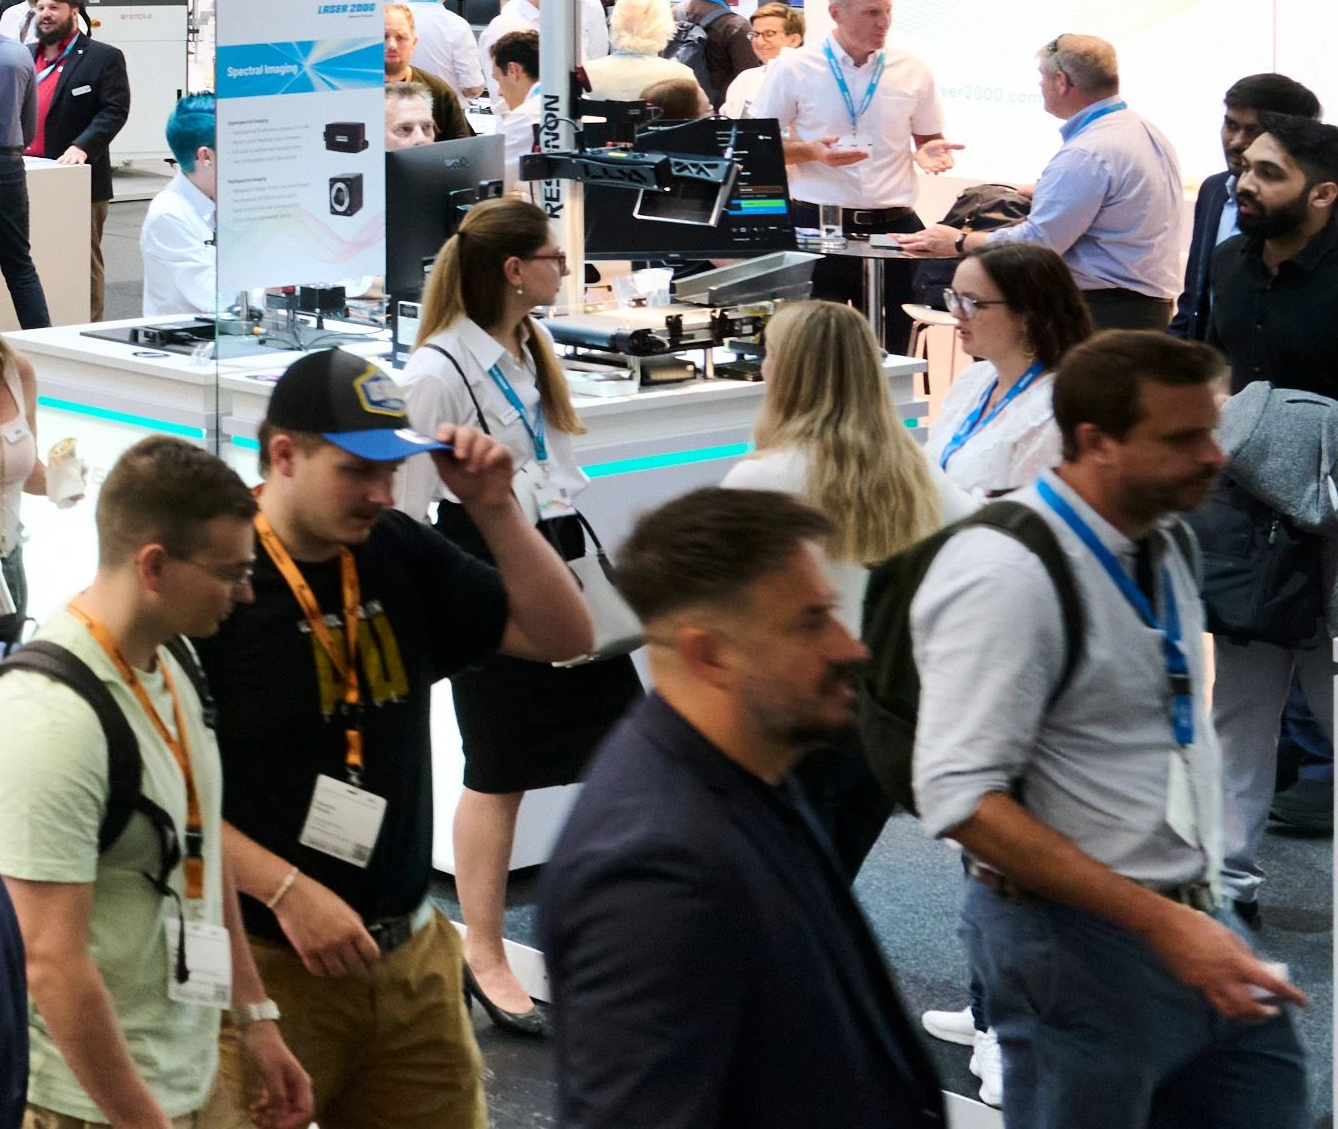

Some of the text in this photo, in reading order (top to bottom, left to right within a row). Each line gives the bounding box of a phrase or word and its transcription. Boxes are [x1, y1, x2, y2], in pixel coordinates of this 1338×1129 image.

[317, 2, 376, 15] LASER 2000
[227, 63, 298, 79] Spectral Imaging
